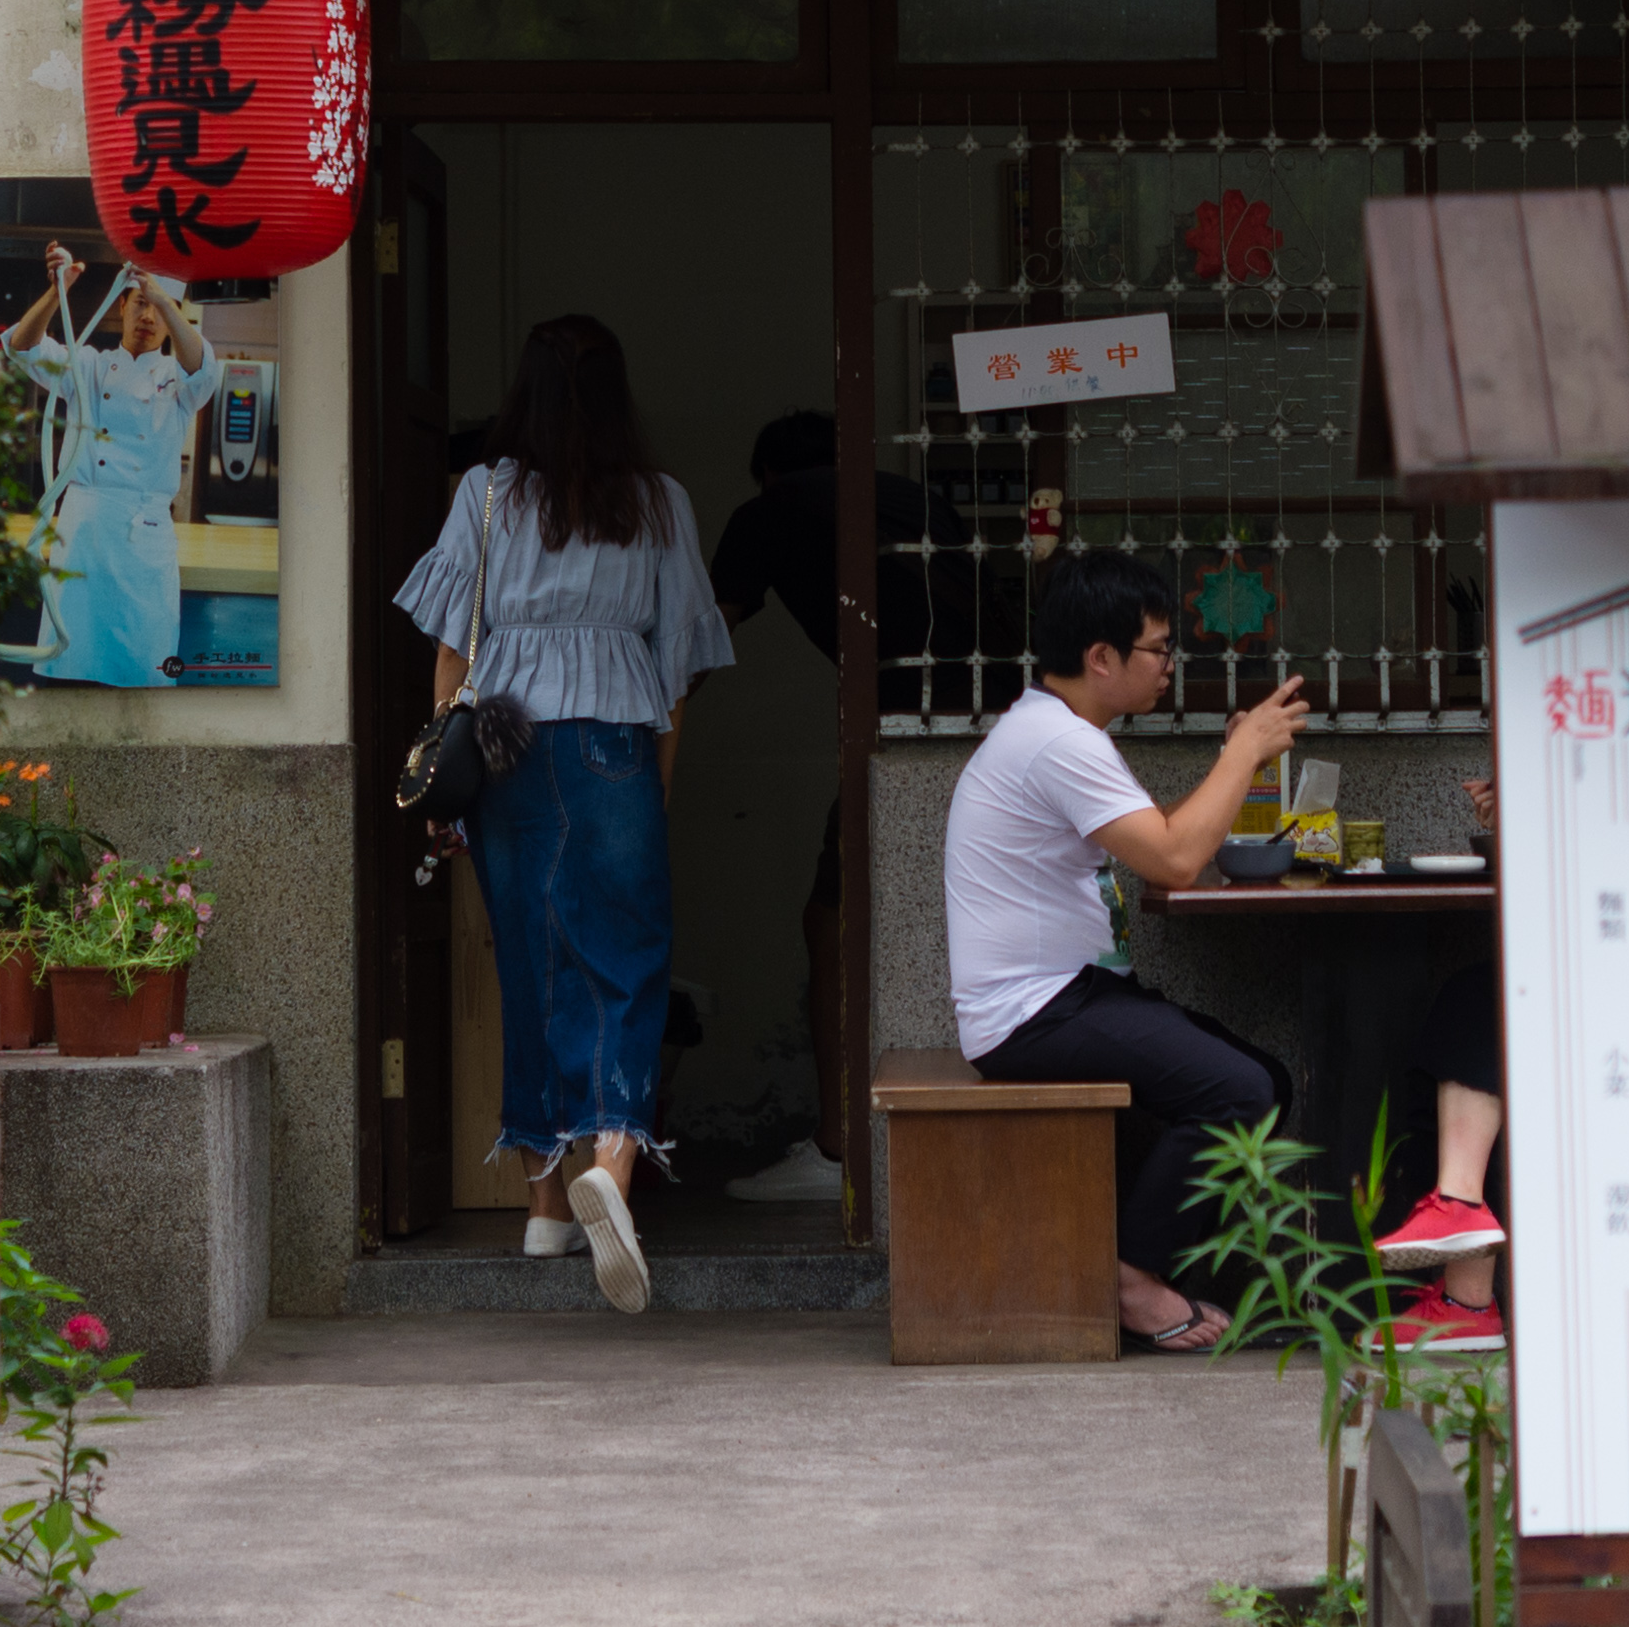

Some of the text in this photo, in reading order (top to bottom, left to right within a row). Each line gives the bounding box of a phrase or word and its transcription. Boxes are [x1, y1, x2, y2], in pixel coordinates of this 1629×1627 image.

[988, 342, 1138, 381] 營業中
[193, 651, 261, 664] 手工拉麵
